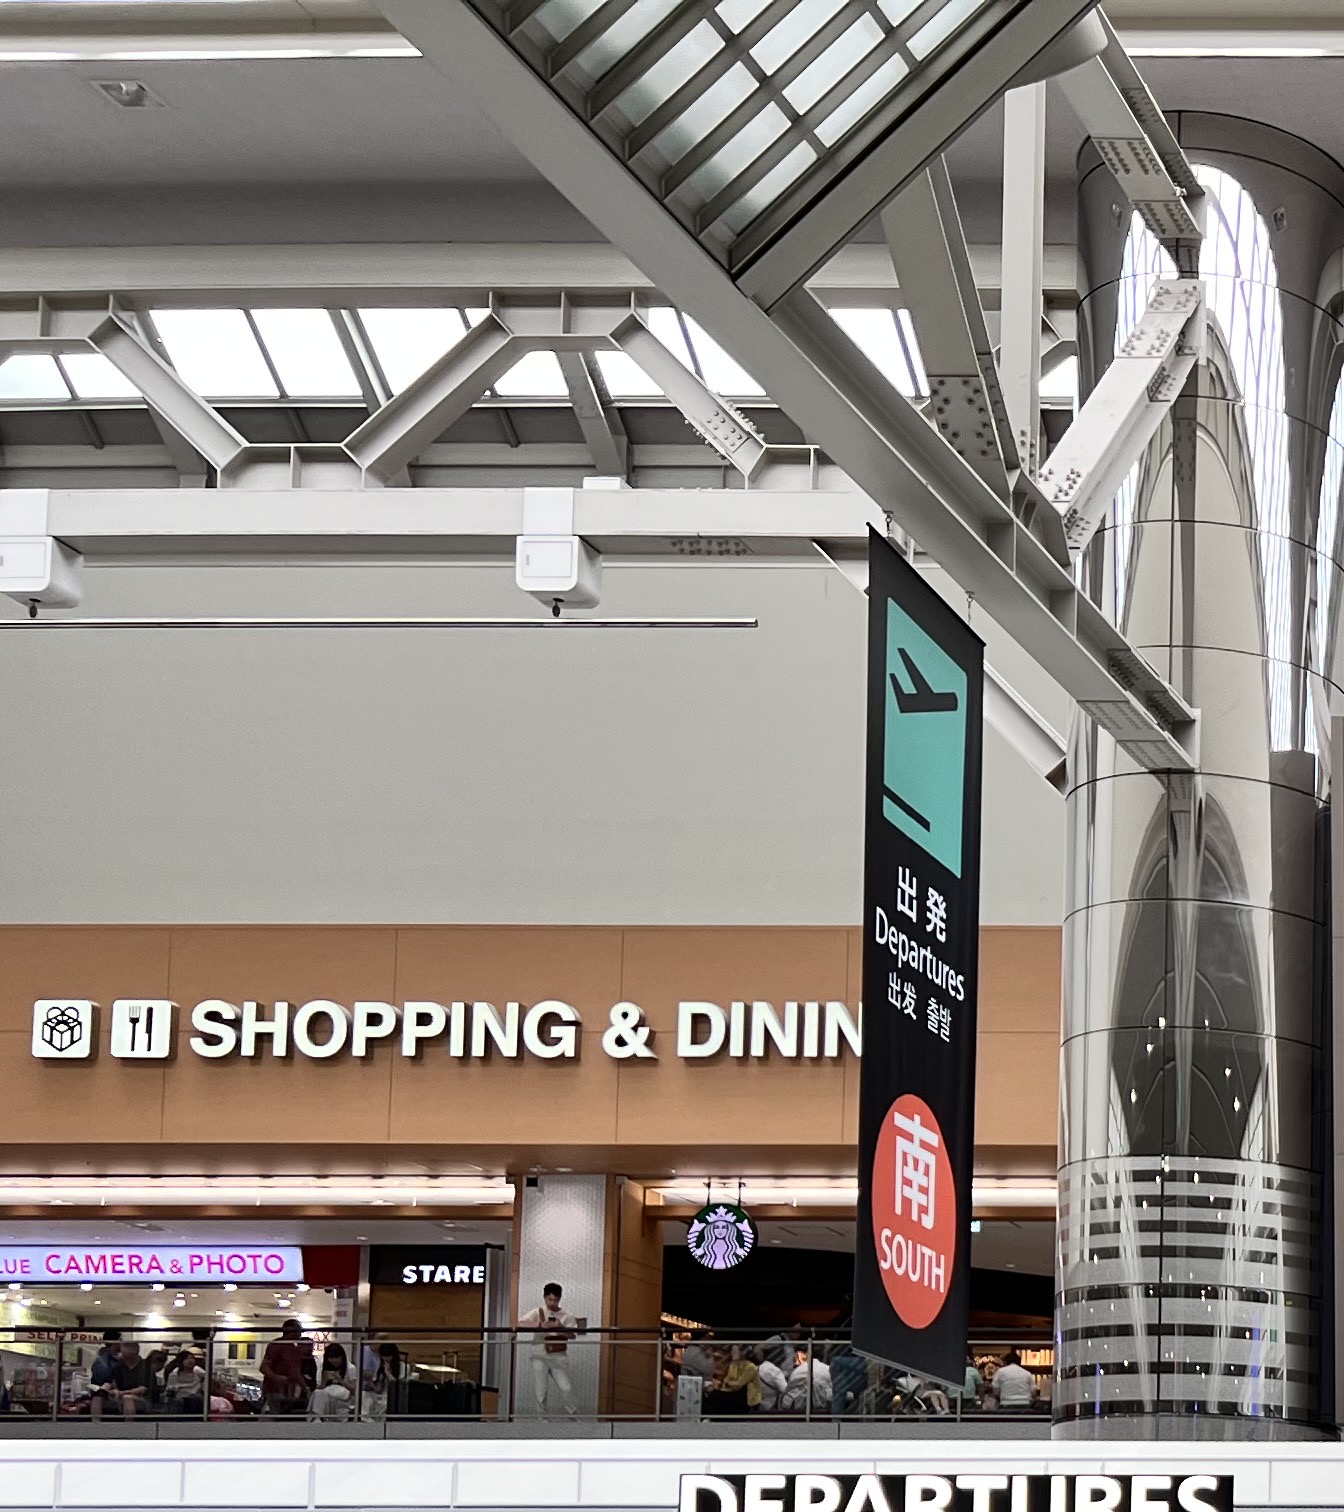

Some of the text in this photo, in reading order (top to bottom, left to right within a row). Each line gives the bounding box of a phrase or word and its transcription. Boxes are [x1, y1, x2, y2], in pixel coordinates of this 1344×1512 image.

[896, 866, 948, 943] 出発
[875, 906, 966, 1002] Departures
[888, 971, 917, 1021] 出发
[926, 997, 954, 1042] 출발
[190, 999, 863, 1060] SHOPPING & DININ
[893, 1110, 939, 1231] 南
[45, 1254, 165, 1275] CAMERA
[169, 1258, 184, 1275] &
[189, 1254, 285, 1275] PHOTO
[879, 1227, 945, 1294] SOUTH
